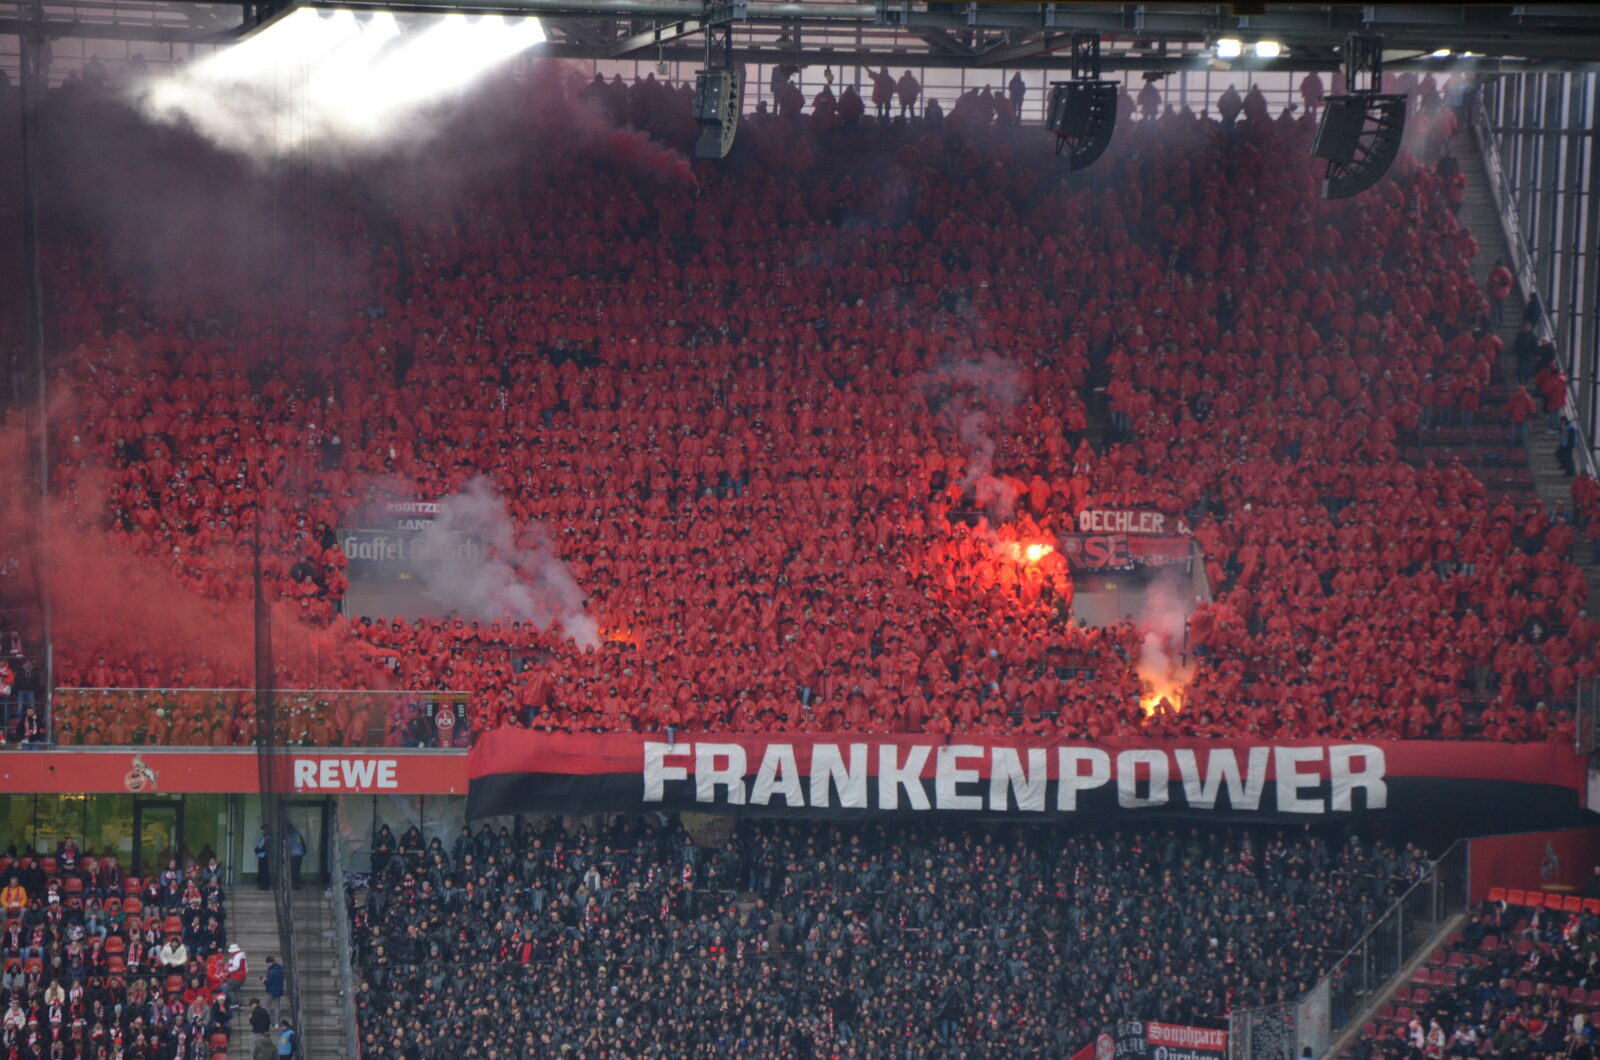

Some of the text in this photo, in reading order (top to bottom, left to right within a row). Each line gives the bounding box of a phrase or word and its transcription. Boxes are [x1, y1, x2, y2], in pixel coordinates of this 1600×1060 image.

[1079, 510, 1165, 533] OECHLER
[344, 536, 406, 562] Gaffel
[293, 759, 398, 789] REWE
[643, 741, 1388, 814] FRANKENPOWER
[1153, 1046, 1220, 1060] Nürnb
